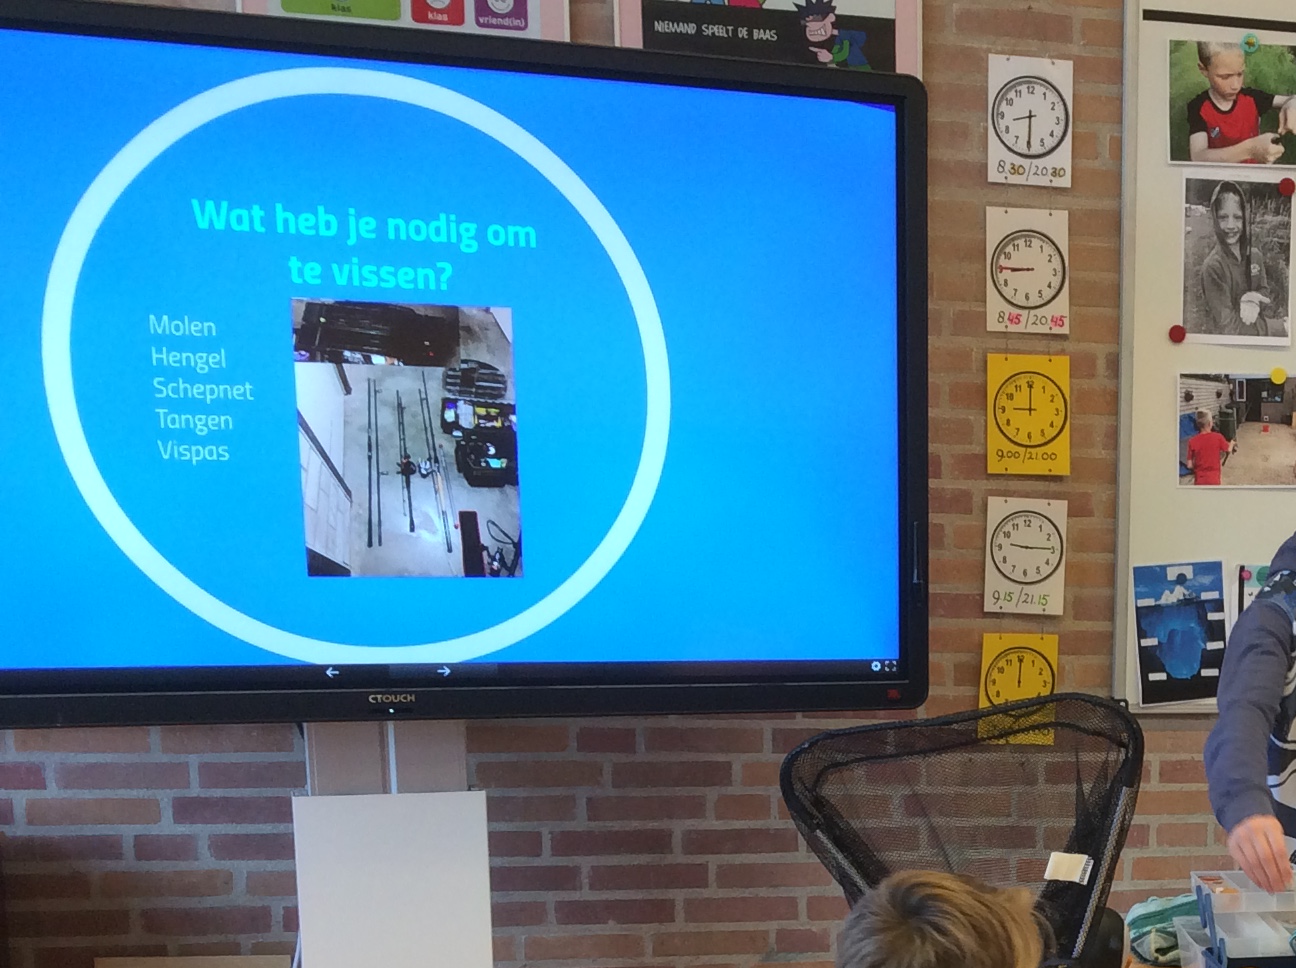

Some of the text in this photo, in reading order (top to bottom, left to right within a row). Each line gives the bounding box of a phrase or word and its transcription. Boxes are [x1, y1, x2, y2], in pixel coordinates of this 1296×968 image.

[427, 11, 449, 22] klas
[478, 16, 526, 28] vriend(in)
[654, 20, 778, 41] NIEMAND SPEELT DE BAAS
[191, 199, 537, 253] Wat heb je nodig om
[289, 256, 453, 291] te vissen?
[149, 314, 216, 336] Molen
[151, 346, 226, 374] Hengel
[153, 377, 254, 404] Schepnet
[155, 408, 233, 436] Tangen
[157, 439, 230, 465] Vispas
[368, 694, 416, 703] CTOUCH
